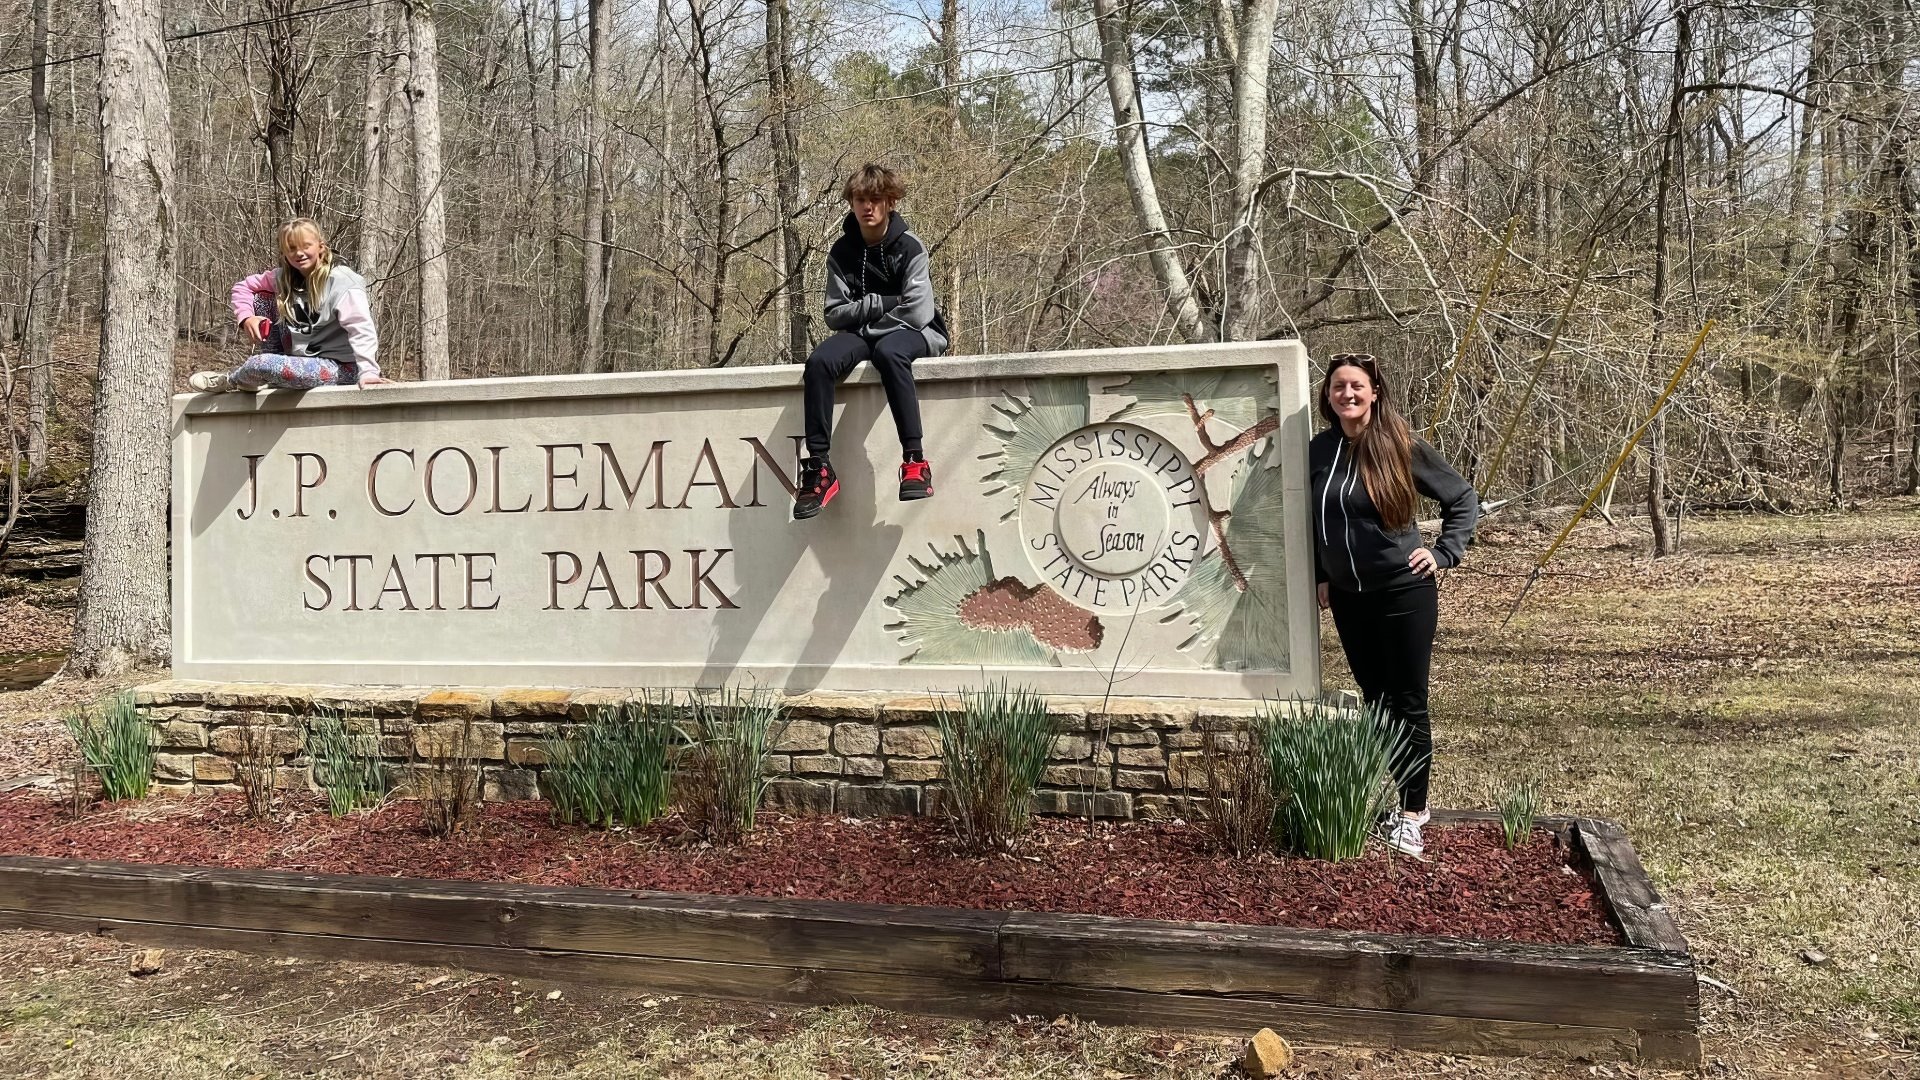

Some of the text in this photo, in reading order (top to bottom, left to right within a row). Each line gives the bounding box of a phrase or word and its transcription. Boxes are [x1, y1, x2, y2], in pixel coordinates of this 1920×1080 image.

[236, 435, 807, 520] J.P. COLEMAN
[1029, 429, 1201, 511] MISSISSIPPI
[1072, 471, 1141, 504] Always
[1082, 524, 1145, 561] Season
[1107, 502, 1119, 519] in
[302, 547, 741, 612] STATE PARK
[1030, 531, 1200, 607] STATE PARKS
